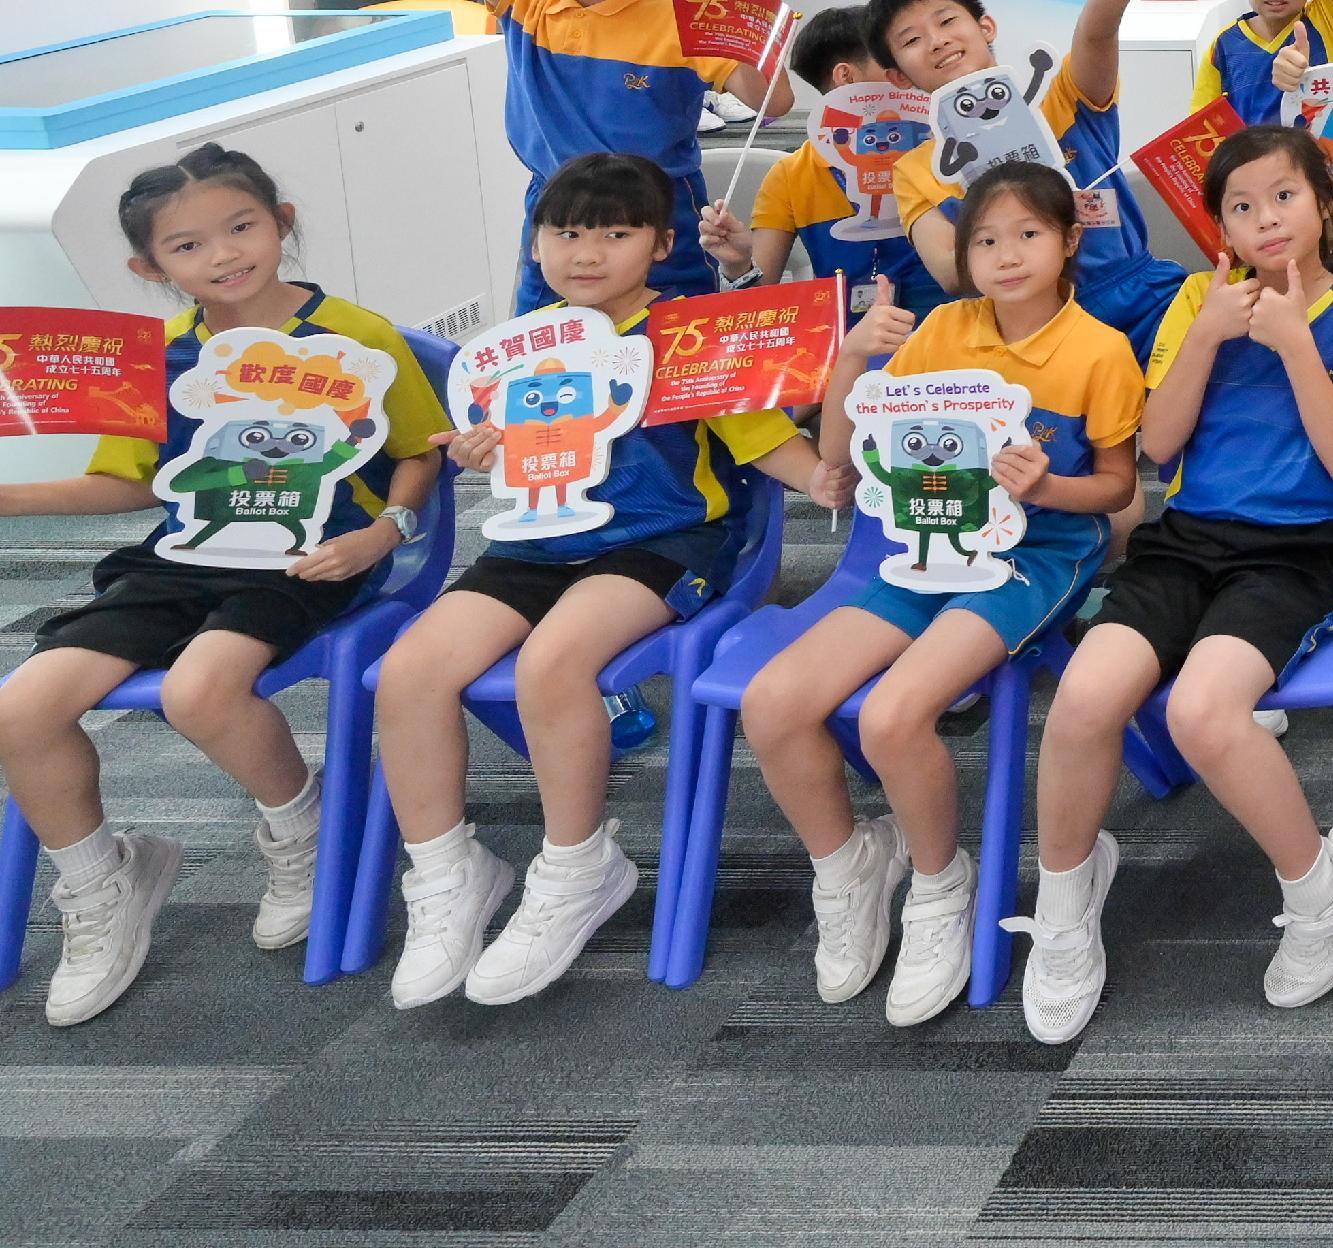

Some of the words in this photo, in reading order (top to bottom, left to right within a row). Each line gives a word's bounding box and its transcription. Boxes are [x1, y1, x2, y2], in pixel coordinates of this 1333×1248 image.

[849, 92, 884, 103] Happy
[889, 92, 931, 103] Birthda
[714, 306, 799, 333] 熱烈慶祝
[474, 318, 587, 372] 共賀國慶
[660, 318, 710, 364] 75
[655, 356, 754, 379] CELEBRATING
[239, 363, 356, 402] 歡度國慶
[926, 382, 990, 397] Celebrate
[856, 402, 878, 414] the
[882, 400, 939, 413] Nation's
[943, 397, 1015, 413] Prosperity
[521, 451, 576, 473] 投票箱
[528, 472, 550, 483] Ballot
[553, 469, 570, 480] Box
[228, 488, 301, 509] 投票箱
[909, 498, 963, 517] 投票箱
[235, 508, 265, 516] Ballot
[268, 508, 289, 516] Box
[915, 516, 938, 525] Ballot
[940, 516, 957, 526] Box
